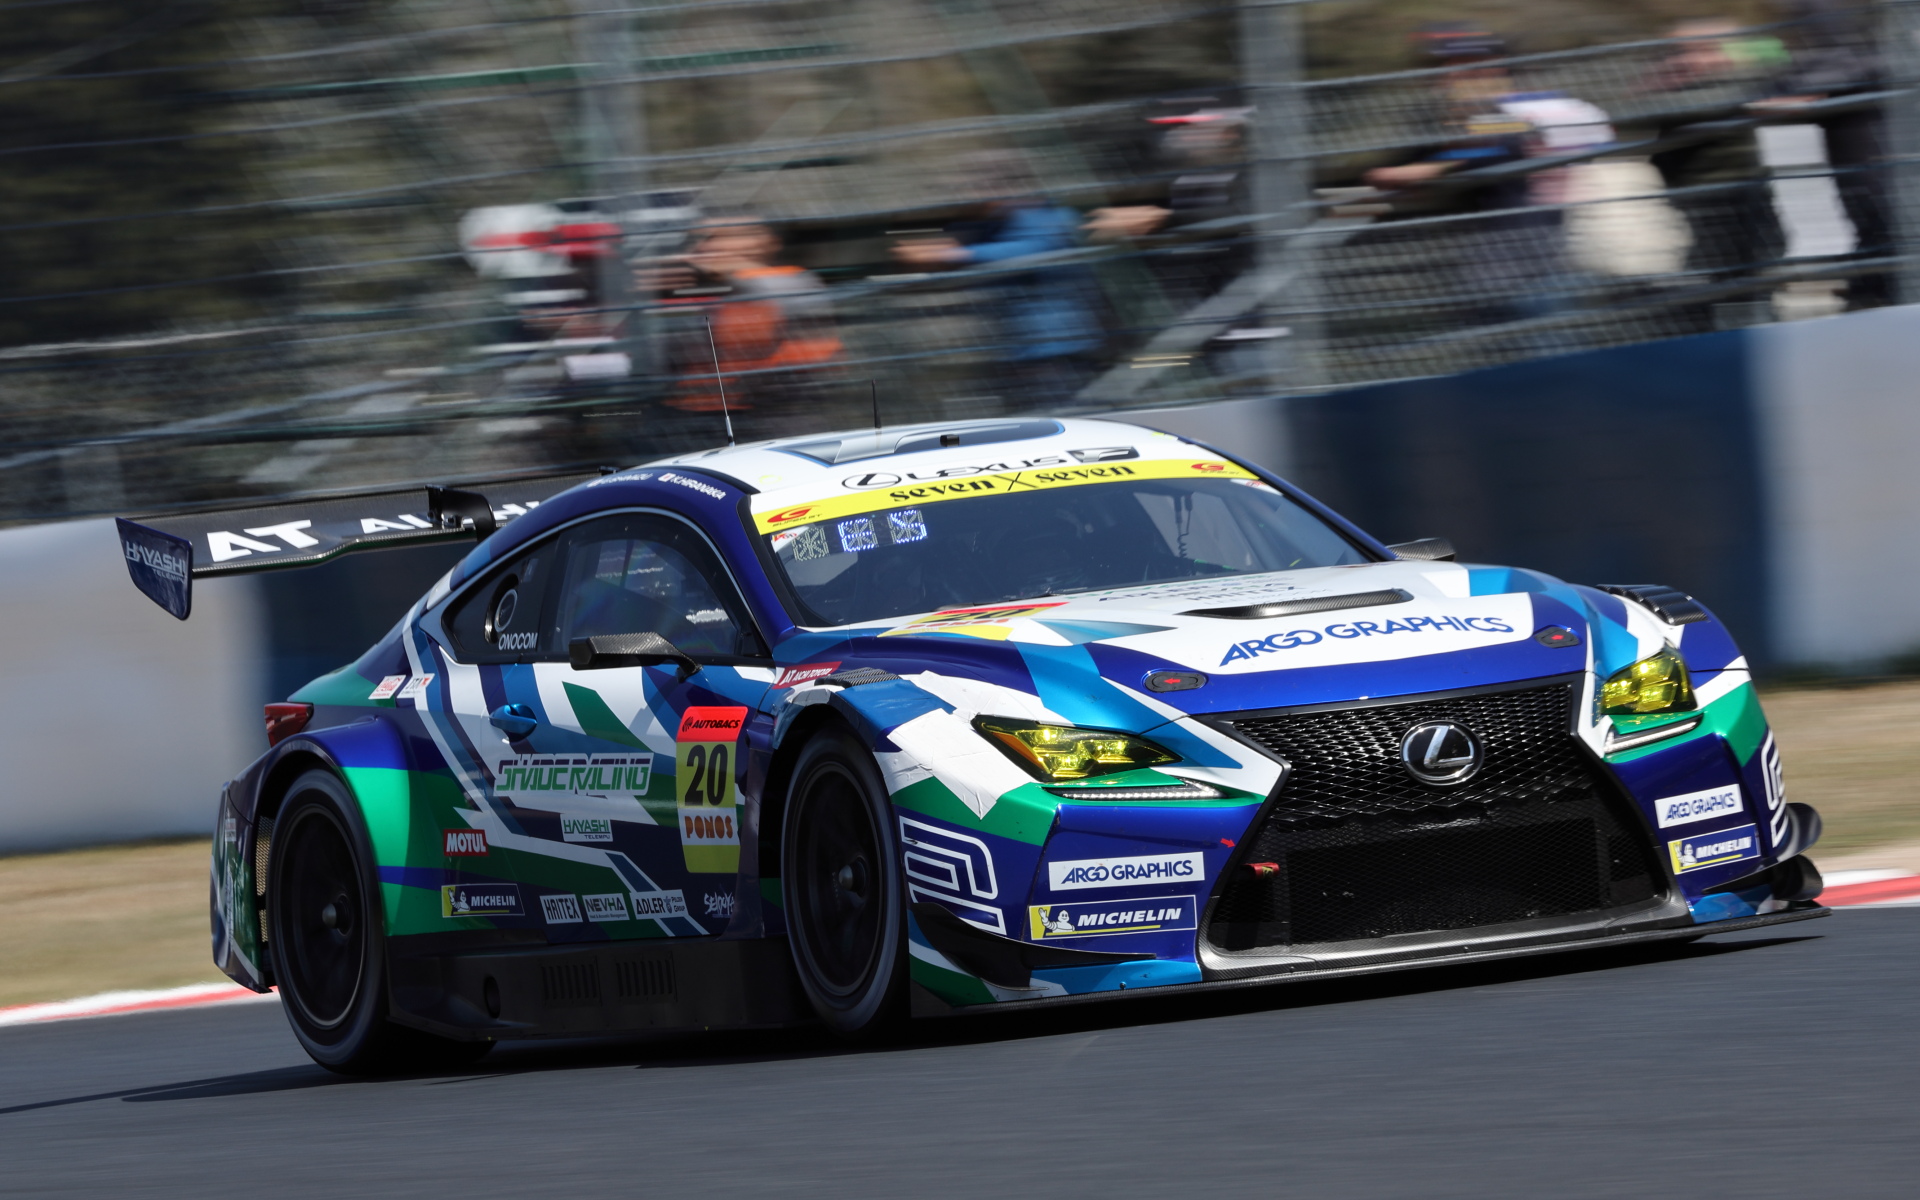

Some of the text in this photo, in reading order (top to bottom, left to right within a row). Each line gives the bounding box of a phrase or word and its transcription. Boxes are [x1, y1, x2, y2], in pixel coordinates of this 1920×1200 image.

[906, 456, 1067, 480] LEXUS
[889, 477, 996, 502] seven
[1035, 465, 1136, 484] seven
[207, 519, 319, 562] AT
[126, 541, 186, 577] HAYASHI
[498, 632, 538, 650] ONOCOM
[1219, 616, 1514, 667] ARGO GRAPHICS
[692, 719, 740, 729] AUTOBACS
[684, 744, 728, 806] 20
[1665, 792, 1736, 821] ARGO GRAPHICS
[563, 819, 611, 834] HAYASHI
[684, 815, 733, 839] PONOS
[446, 833, 487, 853] MOTUL
[1695, 836, 1752, 859] MICHELIN
[1061, 860, 1193, 884] ARGO GRAPHICS
[471, 895, 516, 907] MICHELIN
[585, 897, 625, 912] NEVHA
[636, 897, 666, 915] ADLER
[1077, 907, 1182, 927] MICHELIN
